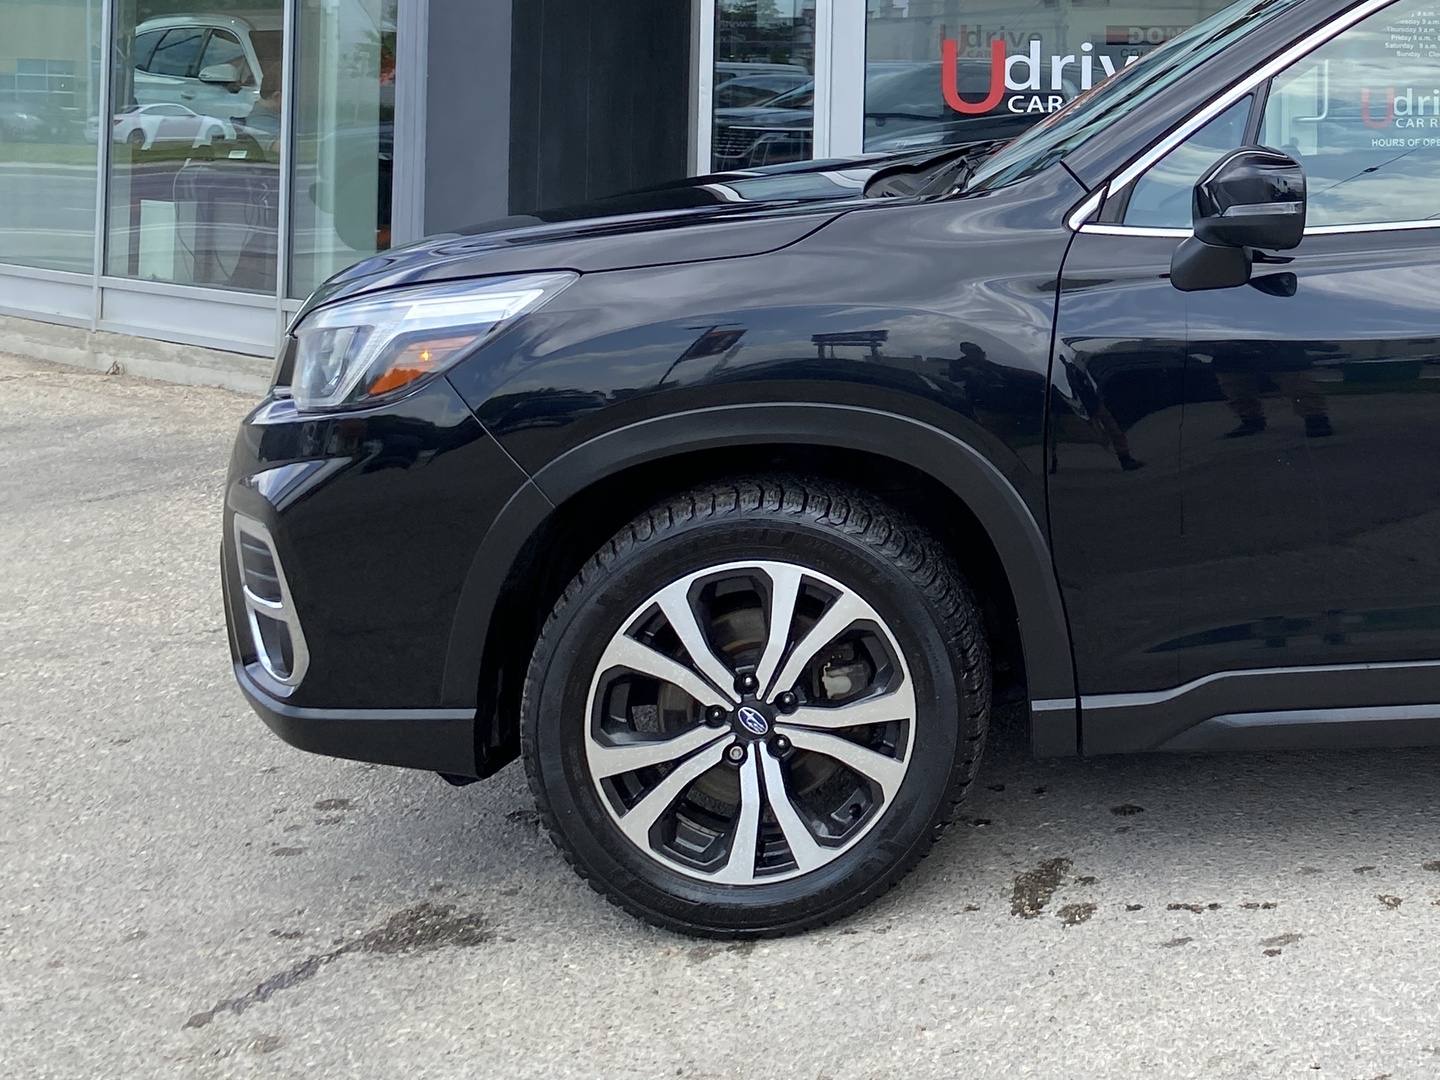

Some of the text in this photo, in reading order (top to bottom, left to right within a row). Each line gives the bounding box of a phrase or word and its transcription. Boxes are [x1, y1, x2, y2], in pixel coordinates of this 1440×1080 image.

[1386, 26, 1417, 34] Thursday
[1390, 34, 1412, 42] Friday
[1385, 42, 1415, 50] Saturday
[1396, 50, 1421, 58] Sunday
[1007, 94, 1064, 114] CAR
[1395, 118, 1425, 129] CAR
[1371, 138, 1405, 147] HOURS
[1407, 138, 1420, 147] OF
